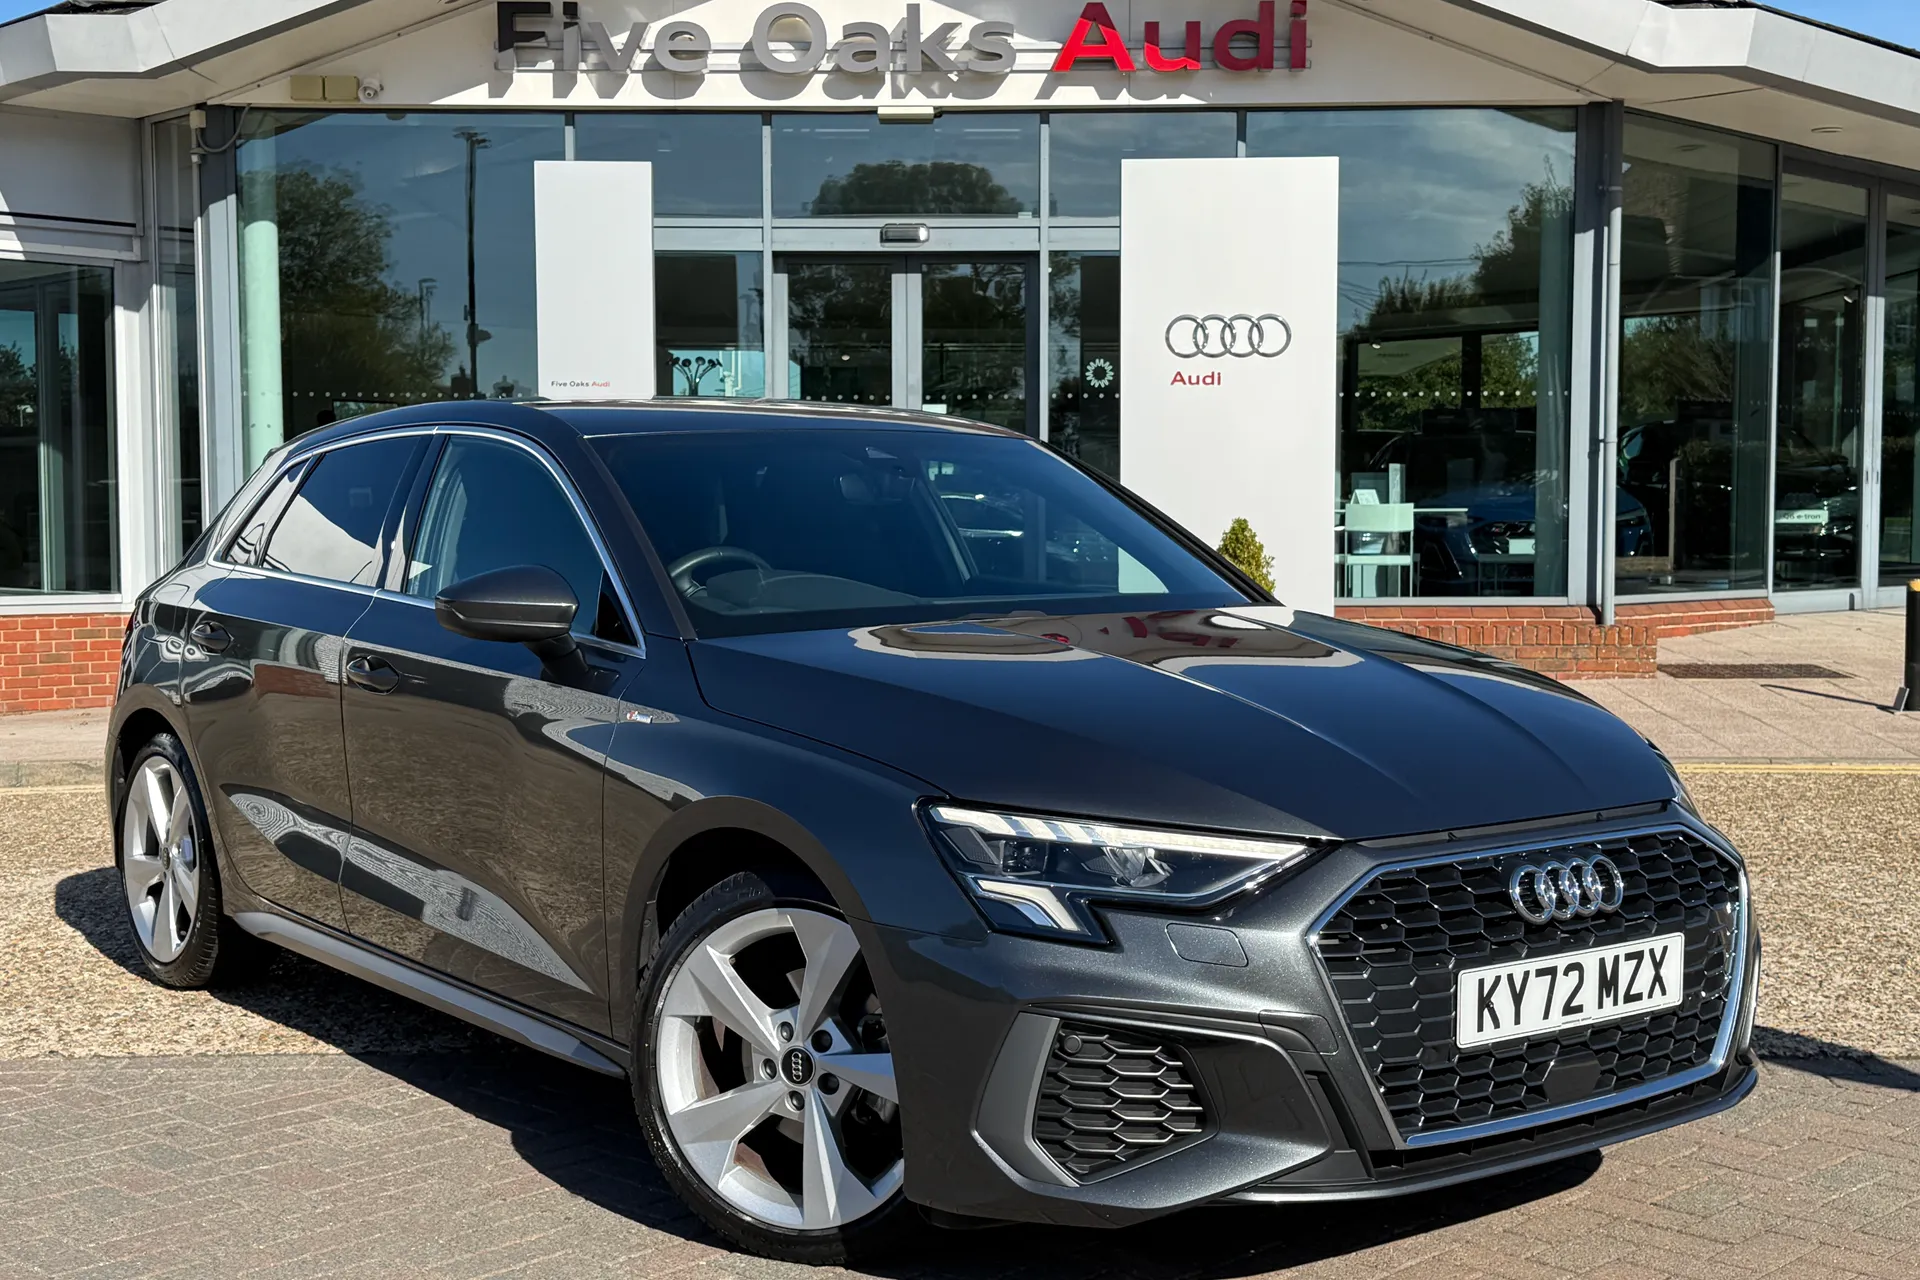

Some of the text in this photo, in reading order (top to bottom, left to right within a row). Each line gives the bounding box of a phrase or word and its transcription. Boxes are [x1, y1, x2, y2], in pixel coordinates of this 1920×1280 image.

[497, 0, 1308, 74] Five Oaks Audi
[551, 380, 568, 388] Five
[569, 380, 590, 388] Oaks
[1170, 371, 1222, 386] Audi
[1477, 945, 1669, 1033] KY72 MZX
